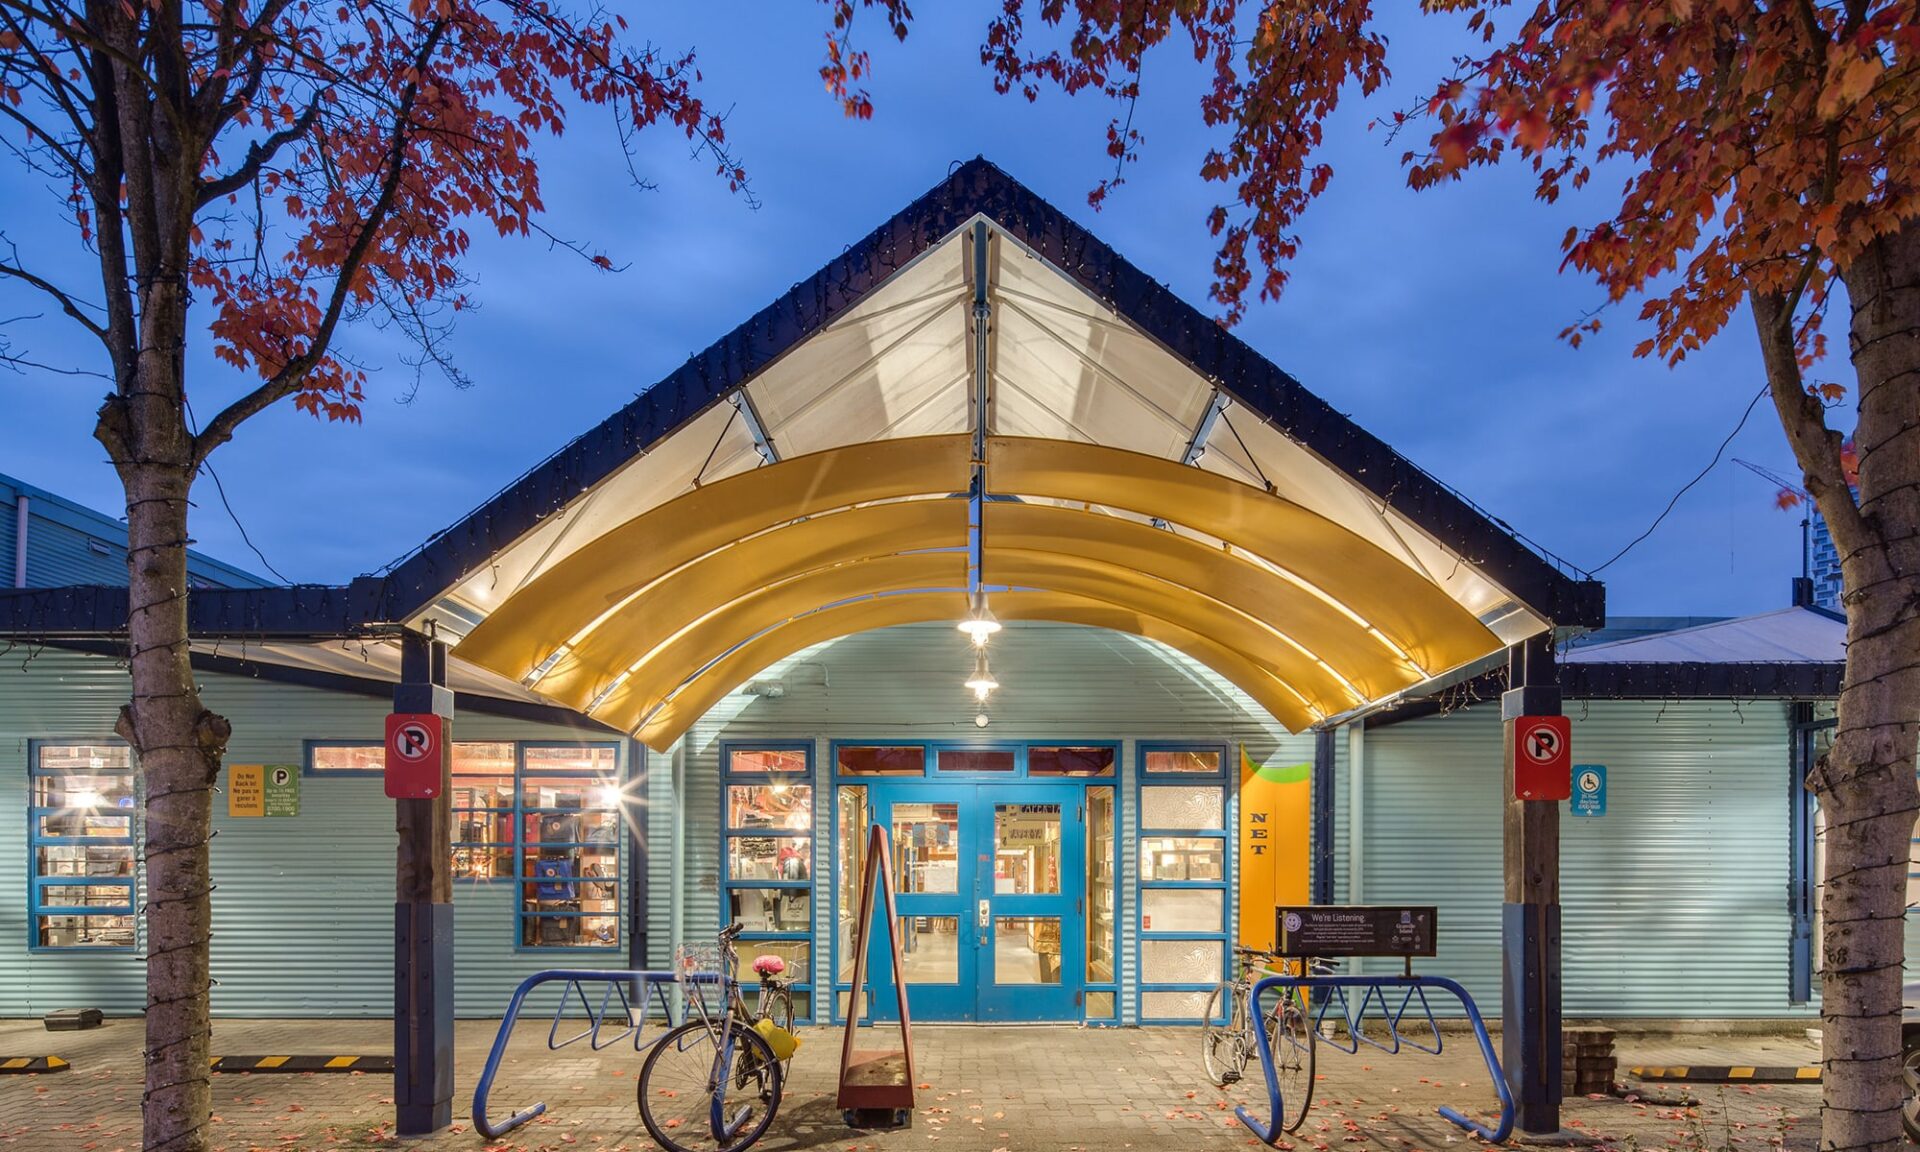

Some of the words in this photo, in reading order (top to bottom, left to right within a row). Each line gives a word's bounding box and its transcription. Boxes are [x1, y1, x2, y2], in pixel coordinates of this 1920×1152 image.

[405, 730, 425, 755] P
[1535, 732, 1554, 757] P
[276, 770, 287, 784] P
[1250, 813, 1268, 855] NET
[1312, 913, 1331, 922] We're
